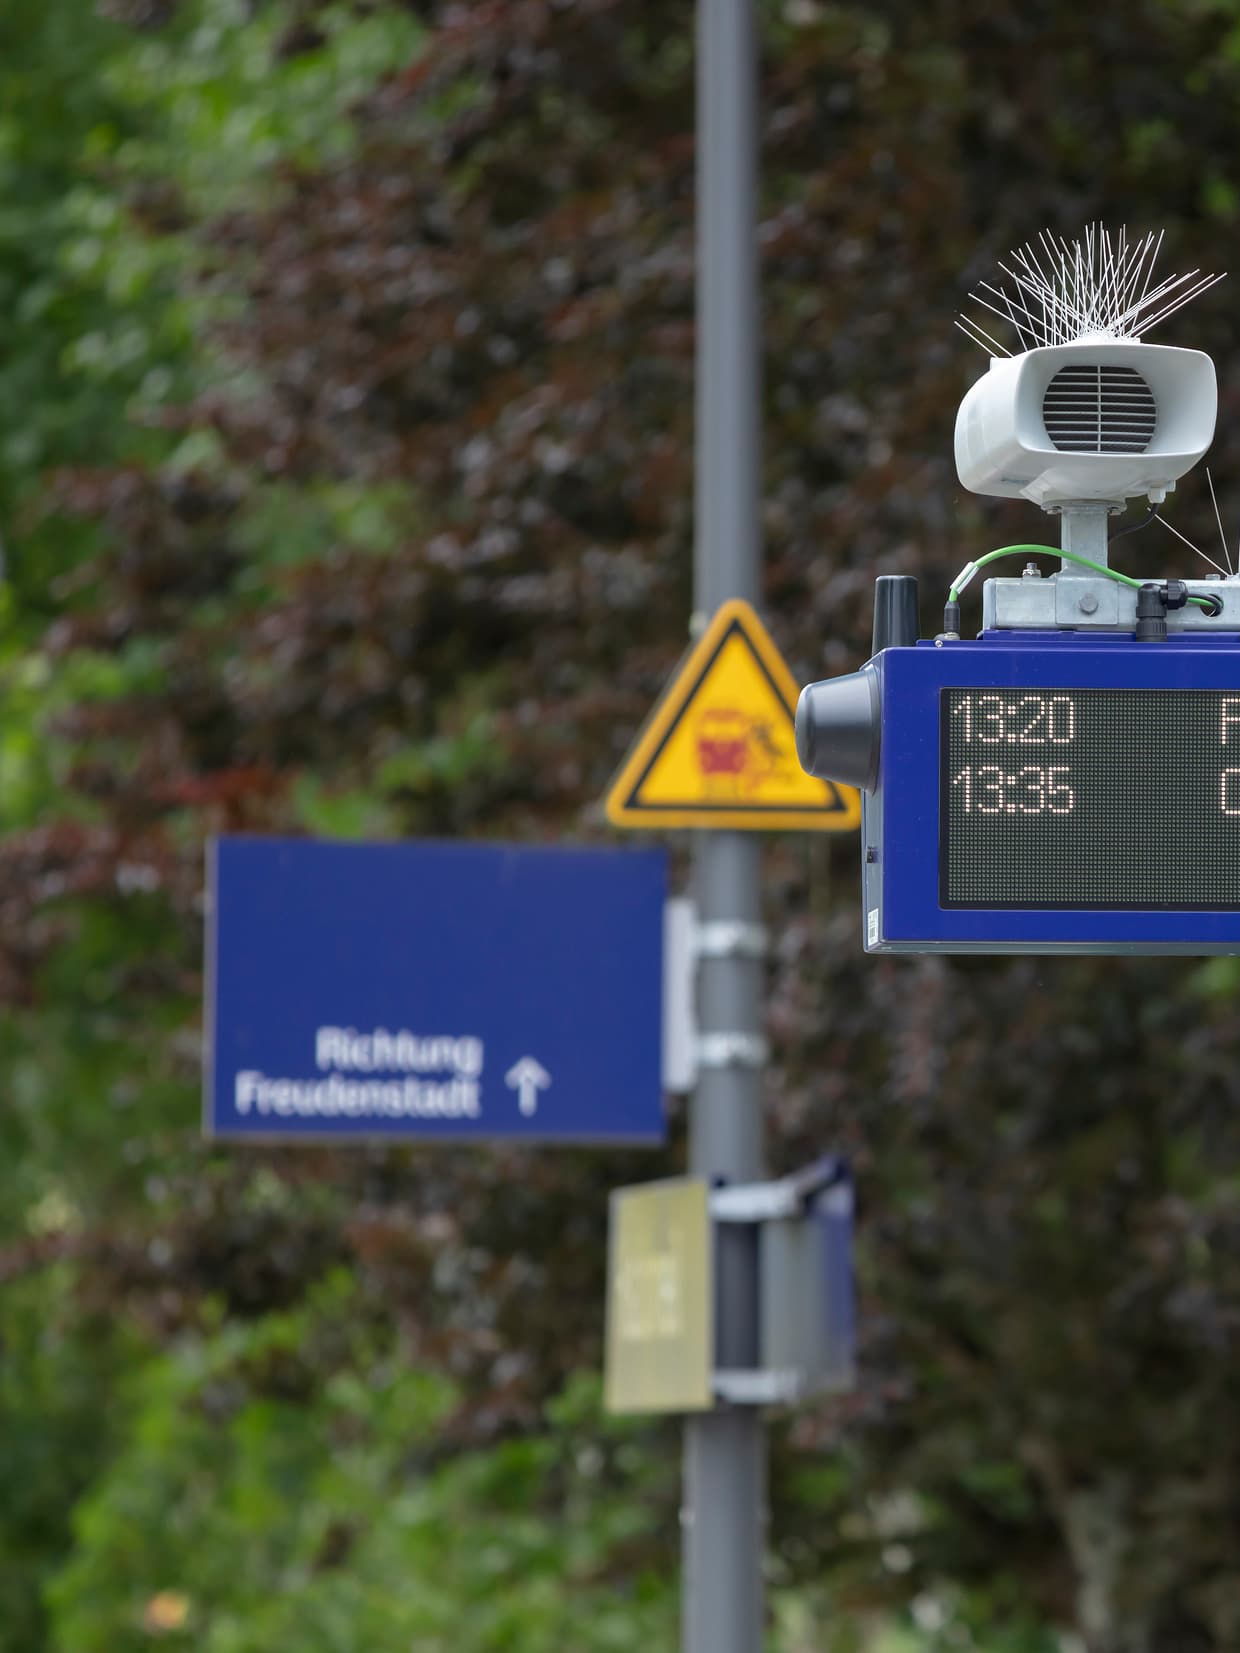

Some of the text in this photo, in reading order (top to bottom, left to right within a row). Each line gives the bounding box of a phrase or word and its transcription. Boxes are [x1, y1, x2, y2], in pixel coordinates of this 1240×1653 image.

[951, 695, 1075, 745] 13:20
[951, 765, 1075, 814] 13:35
[316, 1026, 484, 1076] Richtung
[234, 1070, 482, 1118] Freudenstadt
